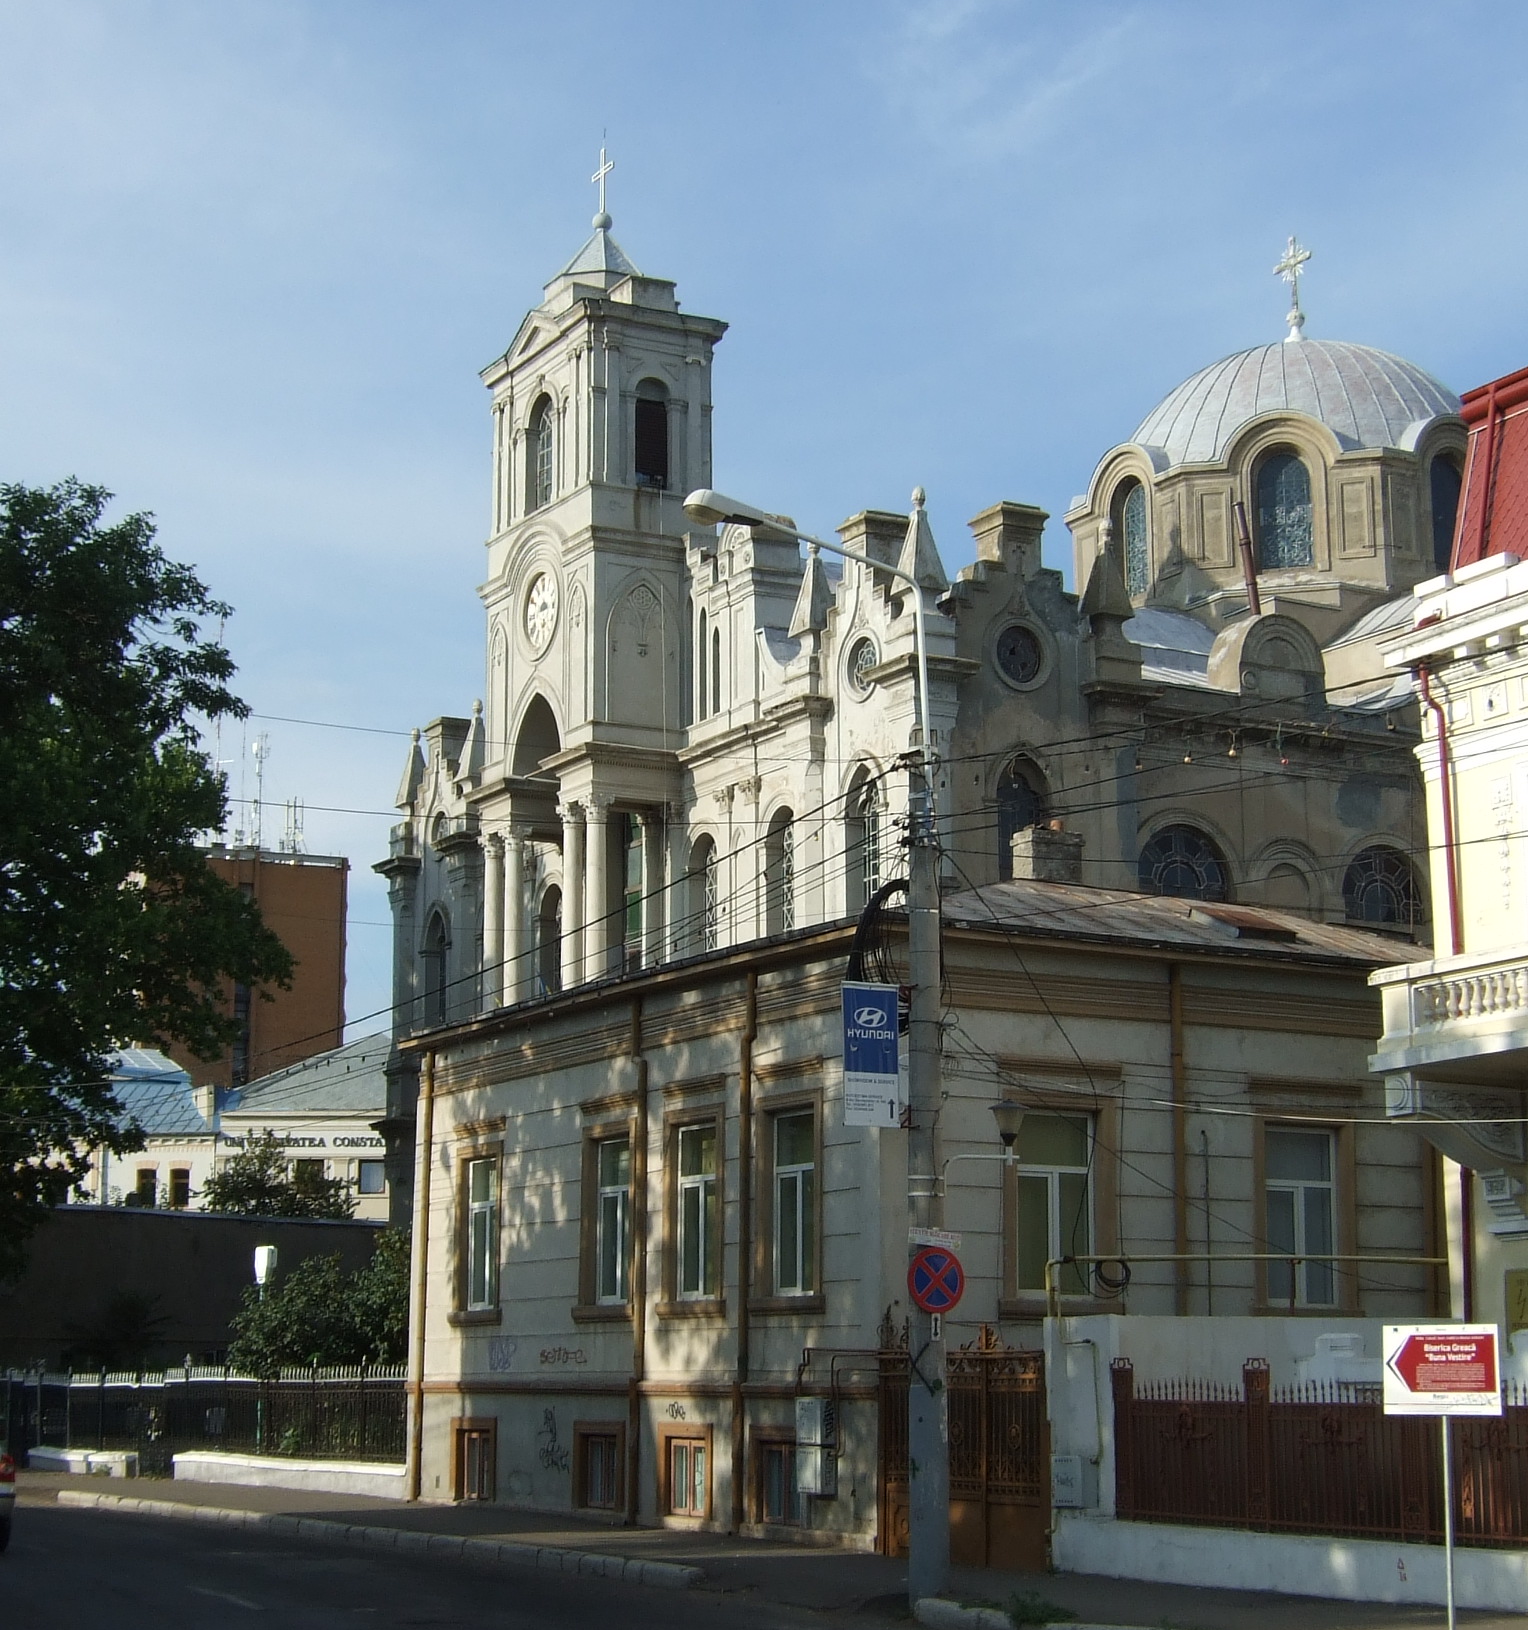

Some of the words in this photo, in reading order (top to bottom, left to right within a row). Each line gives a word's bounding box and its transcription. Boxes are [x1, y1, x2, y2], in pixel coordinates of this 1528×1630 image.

[847, 1028, 894, 1040] HYUNDAI
[223, 1136, 326, 1148] UNIVEITATEA
[1423, 1344, 1451, 1352] Biserica
